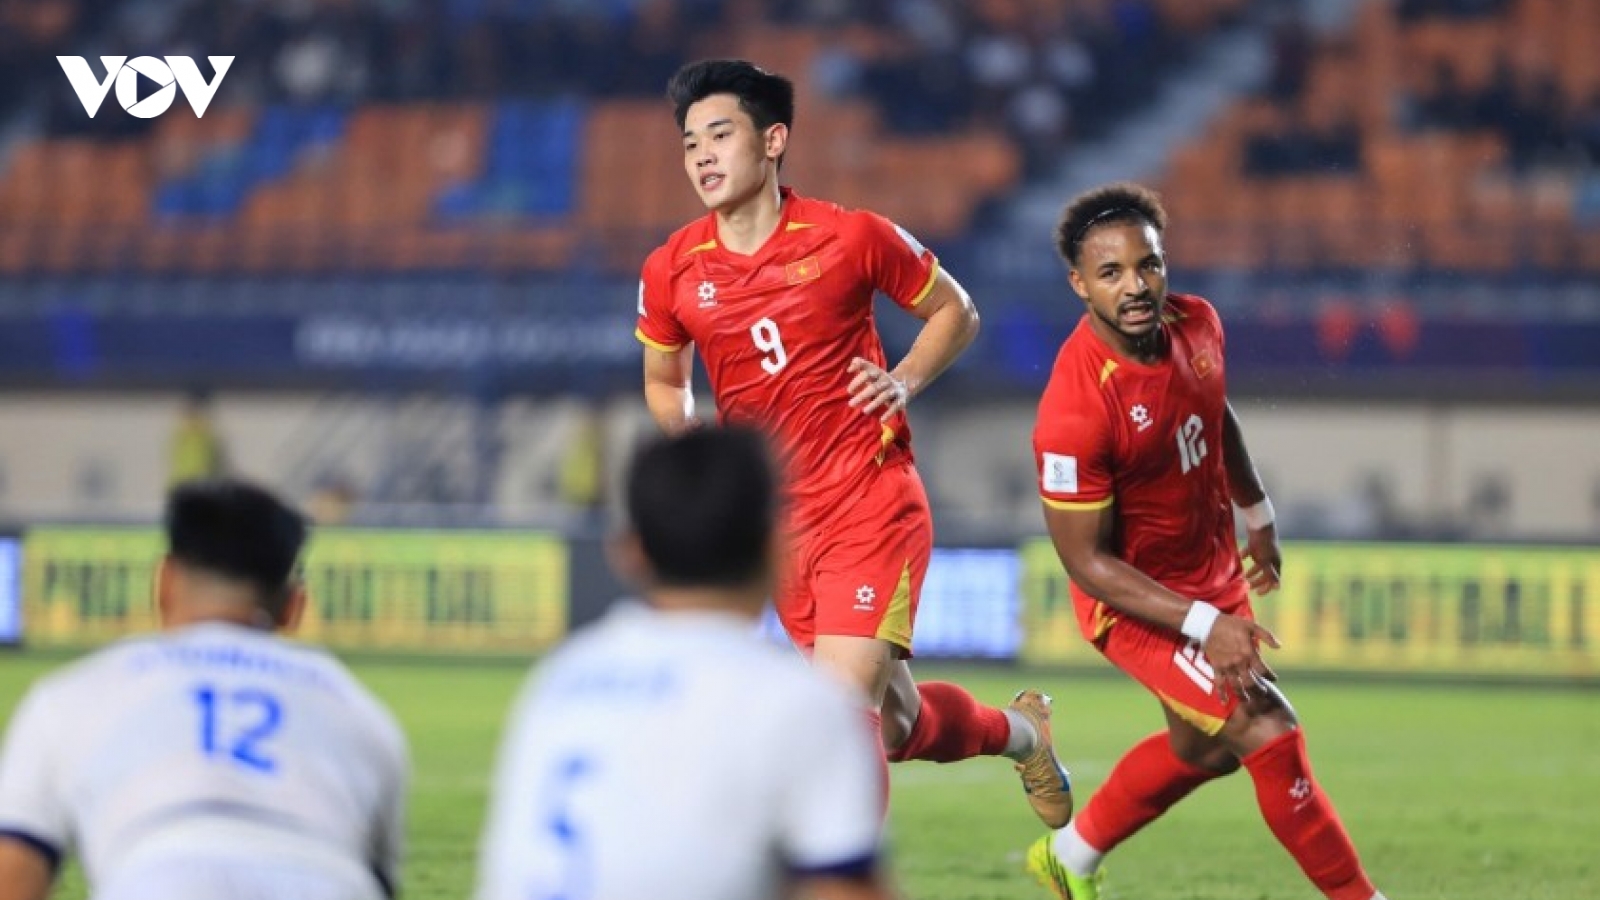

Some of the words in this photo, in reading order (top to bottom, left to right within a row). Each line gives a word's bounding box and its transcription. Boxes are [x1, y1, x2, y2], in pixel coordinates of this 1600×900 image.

[750, 317, 787, 375] 9
[1176, 413, 1208, 475] 12
[190, 685, 284, 774] 12
